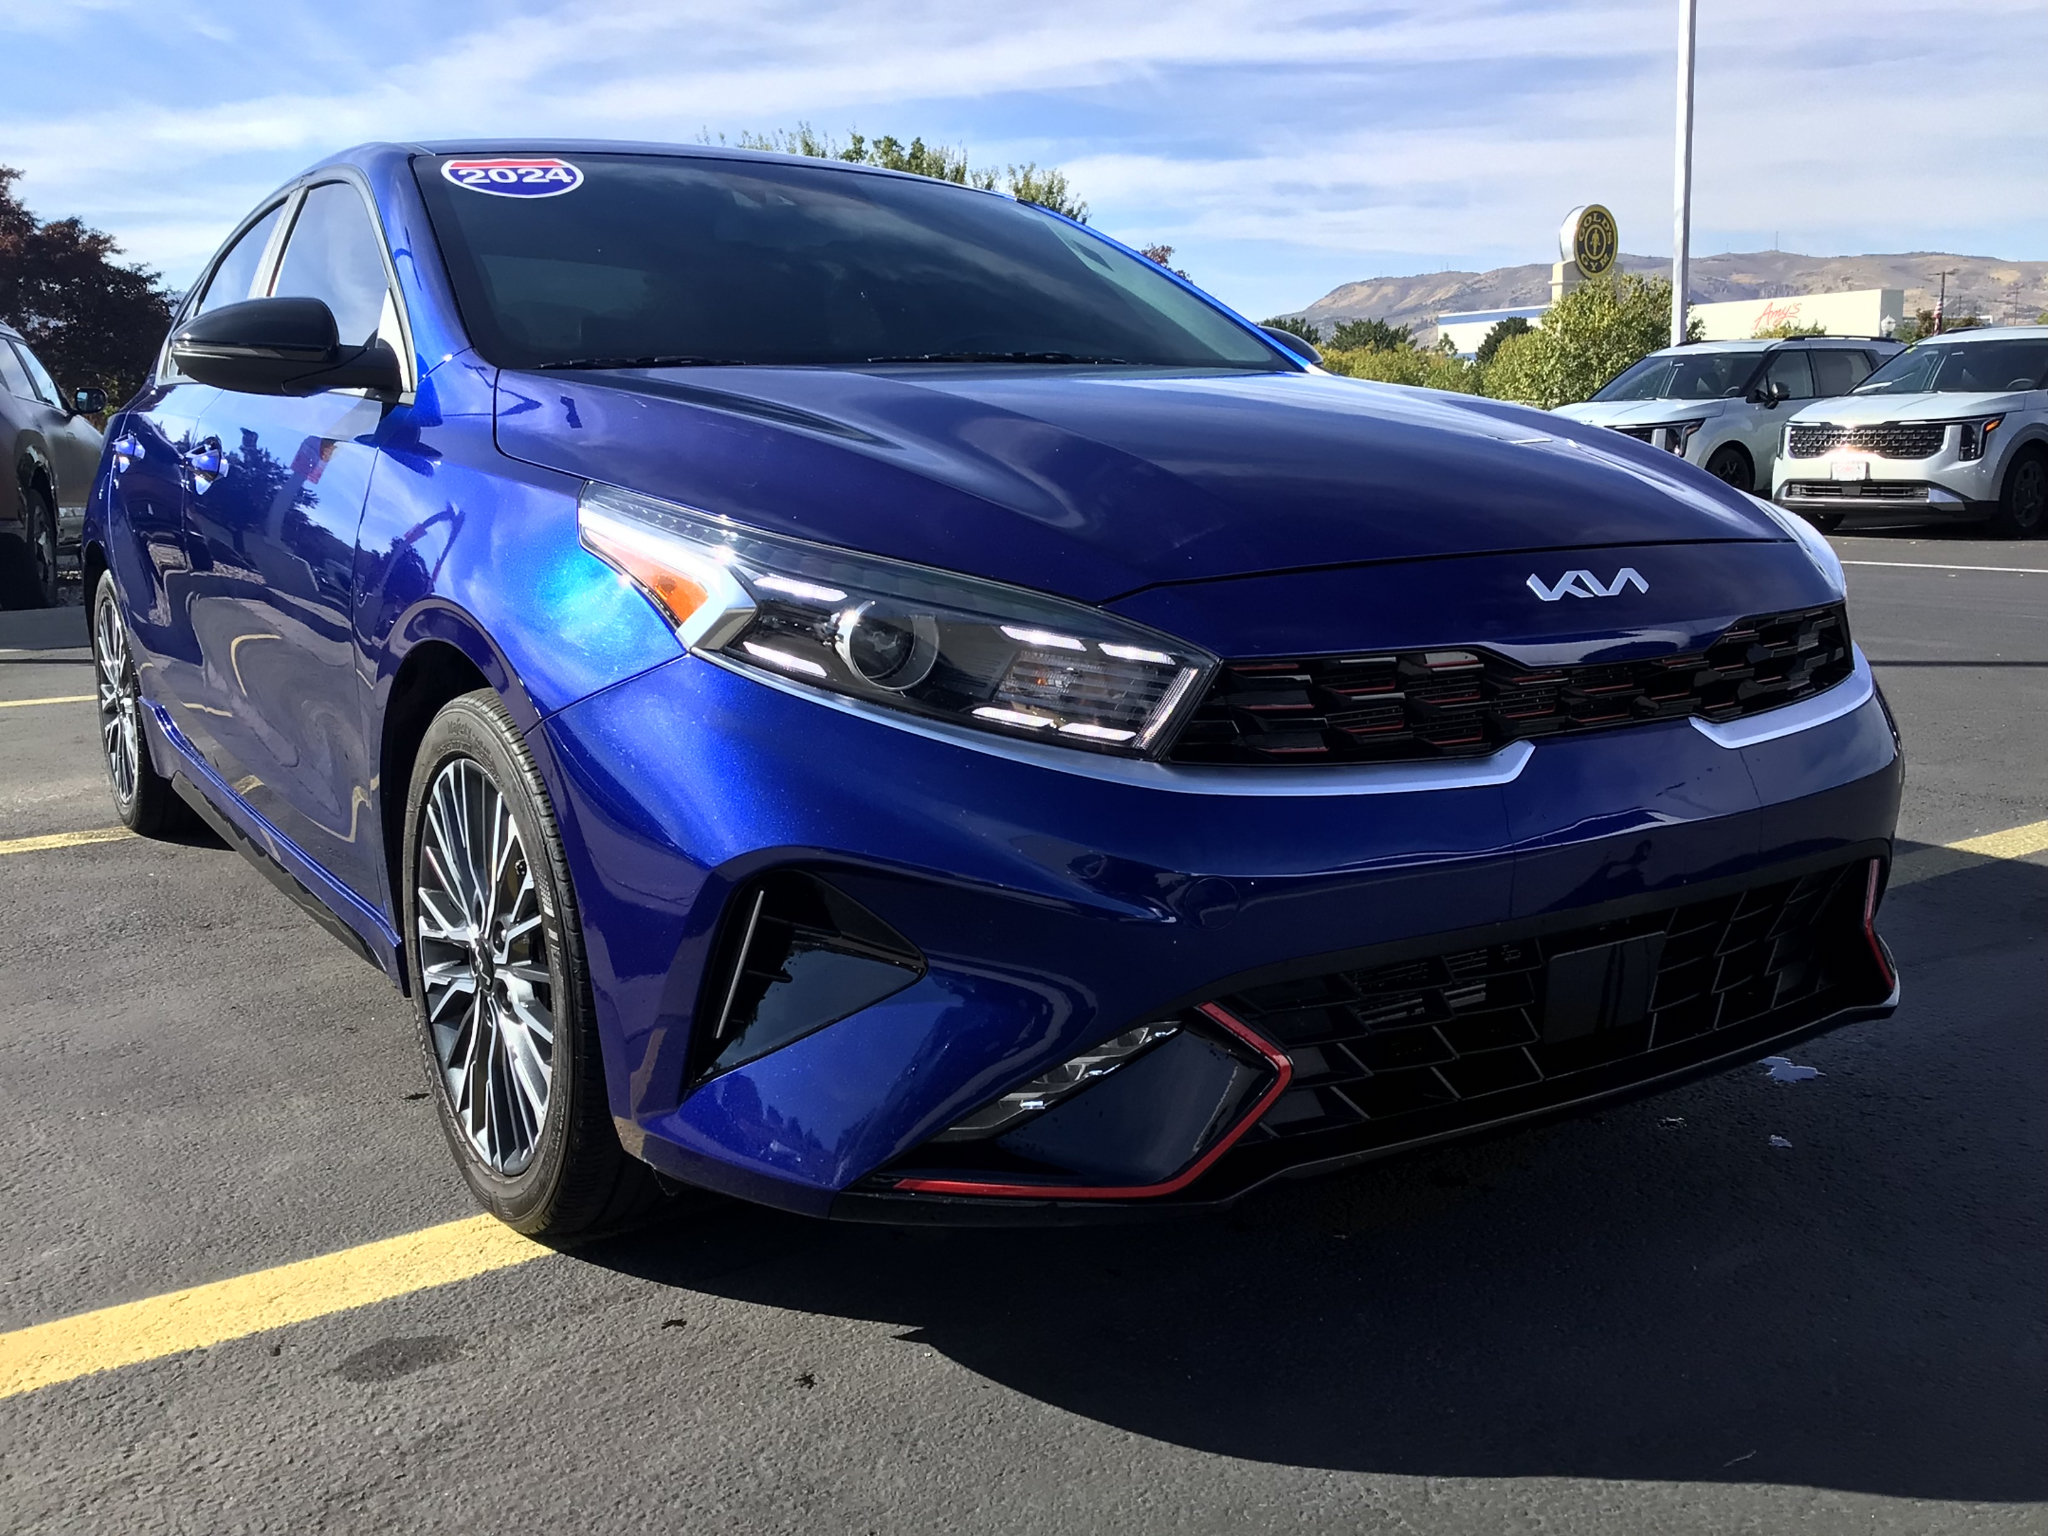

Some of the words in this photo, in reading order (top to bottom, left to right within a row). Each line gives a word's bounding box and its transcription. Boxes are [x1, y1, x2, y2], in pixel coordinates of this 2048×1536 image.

[458, 168, 574, 184] 2024
[1578, 212, 1614, 245] GOLD'S
[1581, 253, 1610, 271] GYM
[1526, 567, 1650, 601] KIA
